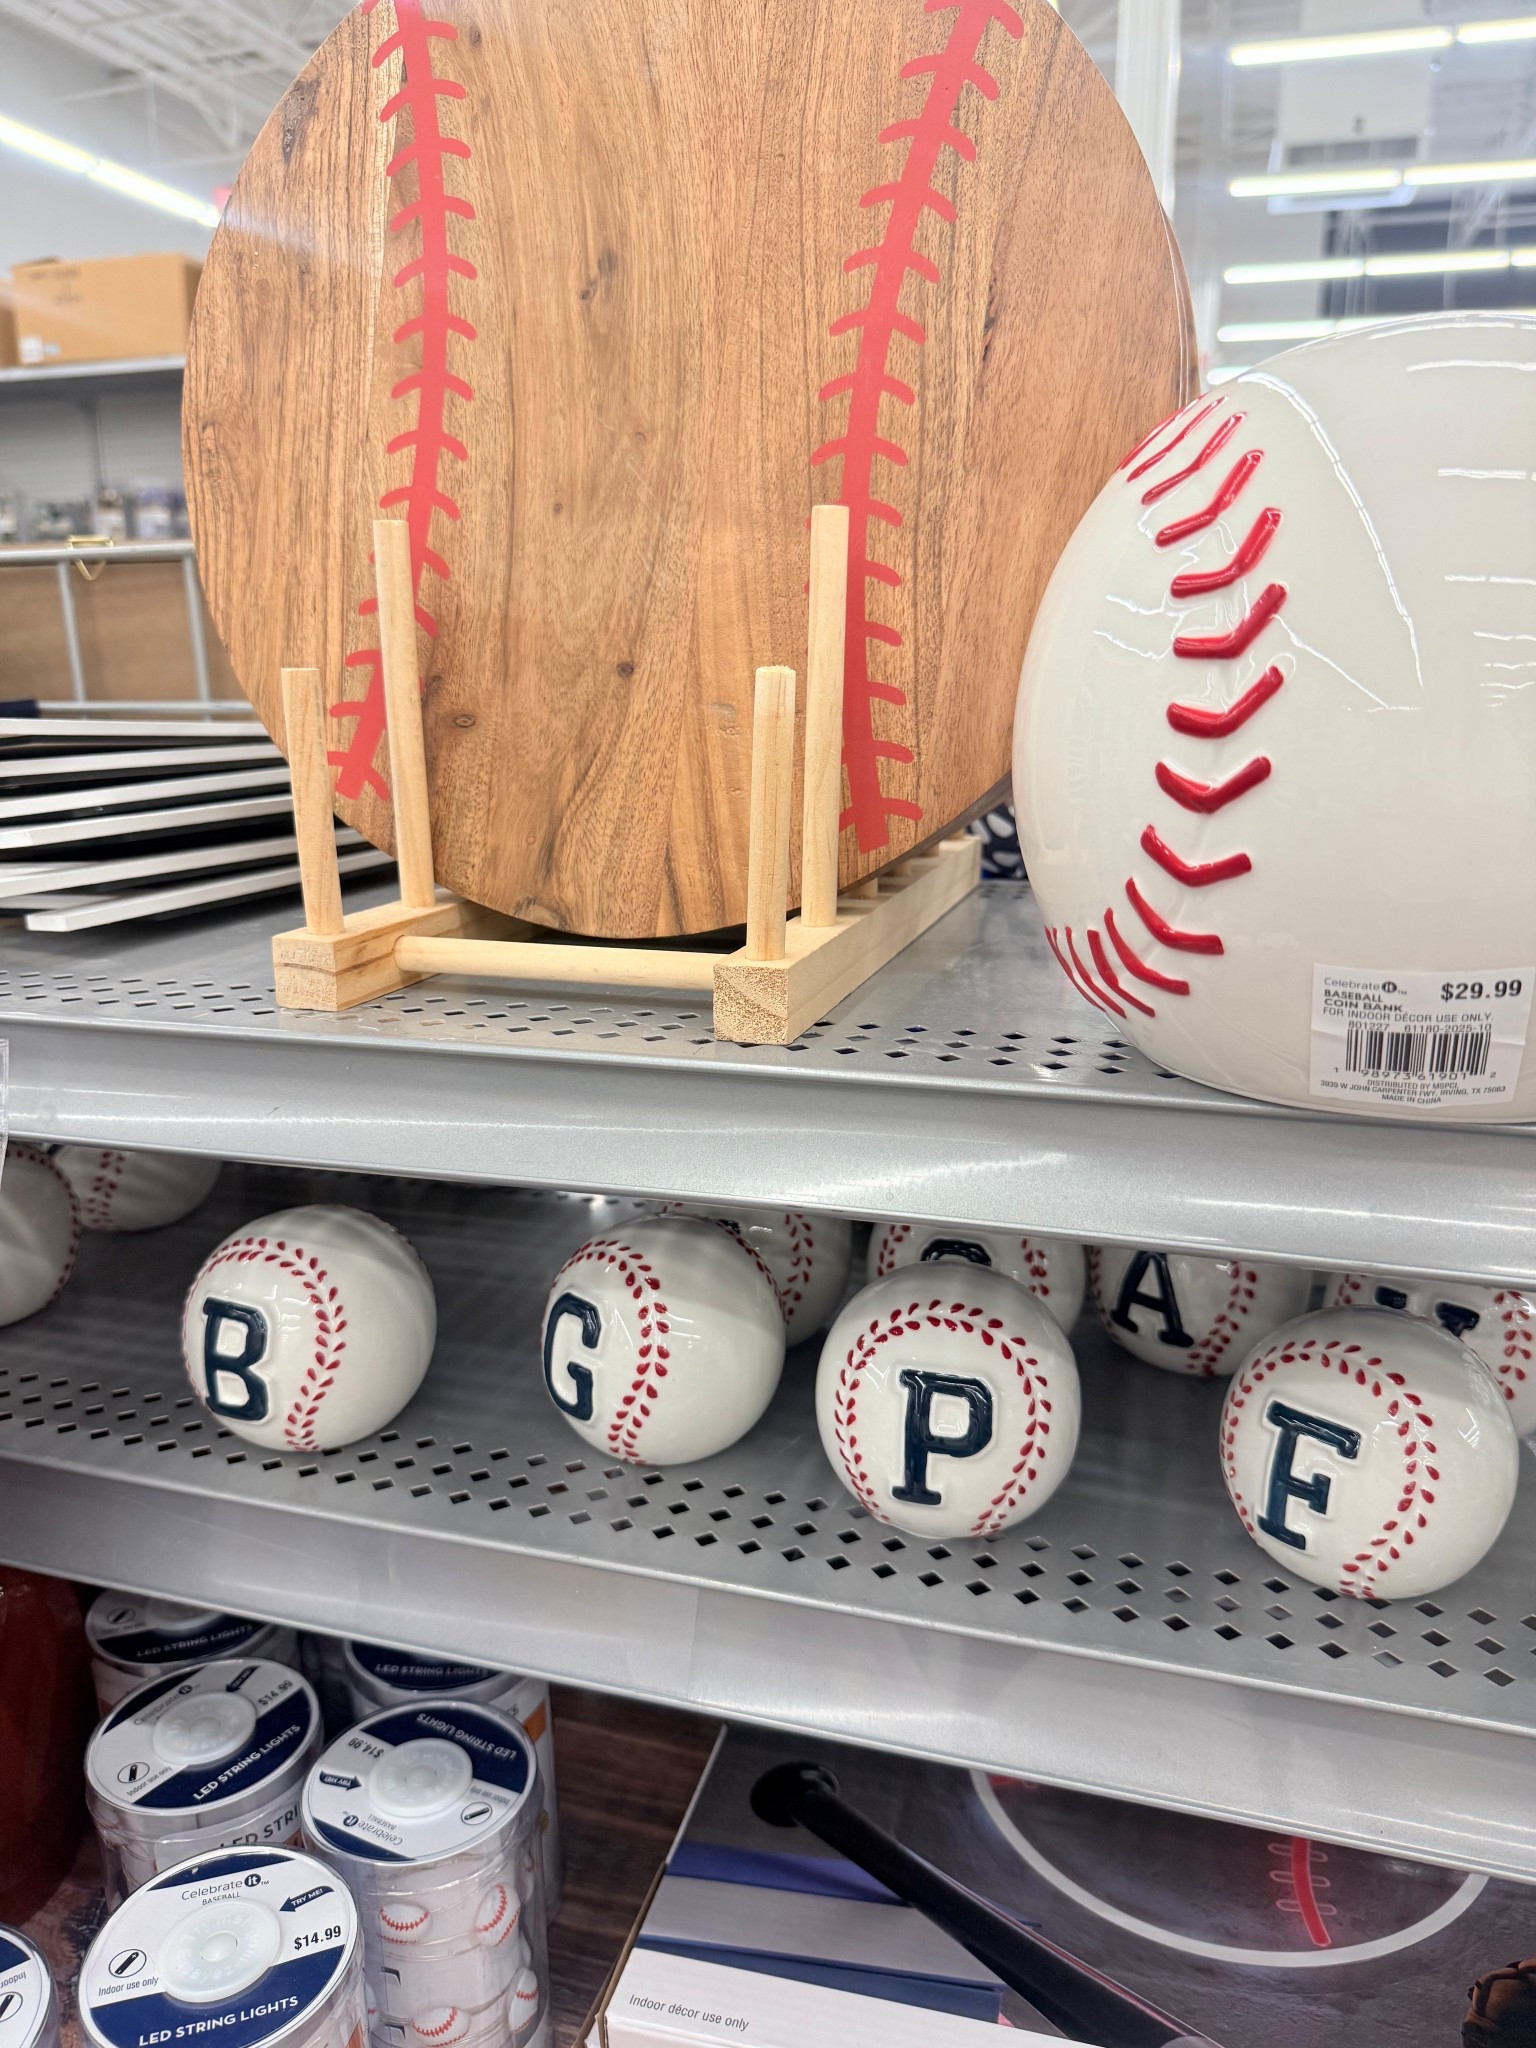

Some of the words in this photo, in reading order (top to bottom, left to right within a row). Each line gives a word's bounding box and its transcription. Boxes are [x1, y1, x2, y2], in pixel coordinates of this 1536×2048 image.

[1323, 977, 1380, 991] Celebrate
[1440, 979, 1522, 1003] $29.99
[1323, 989, 1384, 1003] BASEBALL
[1323, 998, 1358, 1009] COIN
[1363, 1002, 1403, 1013] BANK
[1323, 1006, 1344, 1017] FOR
[1347, 1010, 1390, 1021] INDOOR
[1436, 1014, 1458, 1023] USE
[1348, 1020, 1390, 1032] 801227
[1361, 1069, 1411, 1080] 98973
[1367, 1079, 1418, 1090] DISTRIBUTED
[1350, 1084, 1371, 1092] JOHN
[1372, 1086, 1418, 1097] CARPENTER
[1382, 1094, 1405, 1102] MADE
[1417, 1096, 1441, 1105] CHINA
[1109, 1251, 1194, 1348] A
[202, 1297, 269, 1421] B
[543, 1292, 601, 1421] G
[892, 1368, 994, 1506] P
[1257, 1400, 1362, 1551] F
[416, 1713, 456, 1736] LIGHTS
[348, 1737, 385, 1759] $14.99
[454, 1729, 495, 1752] STRING
[193, 1779, 219, 1800] LED
[217, 1752, 262, 1785] STRING
[260, 1724, 301, 1755] LIGHTS
[493, 1746, 518, 1760] LED
[358, 1820, 403, 1846] Celebrate
[181, 1880, 243, 1901] Celebrate
[202, 1891, 241, 1906] BASEBALL
[291, 1896, 307, 1907] TRY
[308, 1888, 323, 1899] ME!
[294, 1925, 342, 1951] $14.99
[98, 1983, 124, 1997] Indoor
[126, 1981, 141, 1990] use
[142, 1976, 159, 1987] only
[139, 2029, 172, 2047] LED
[175, 2013, 236, 2039] STRING
[240, 1995, 299, 2022] LIGHTS
[628, 1994, 666, 2012] Indoor
[668, 2003, 700, 2020] décor
[702, 2012, 722, 2025] use
[724, 2016, 749, 2032] only
